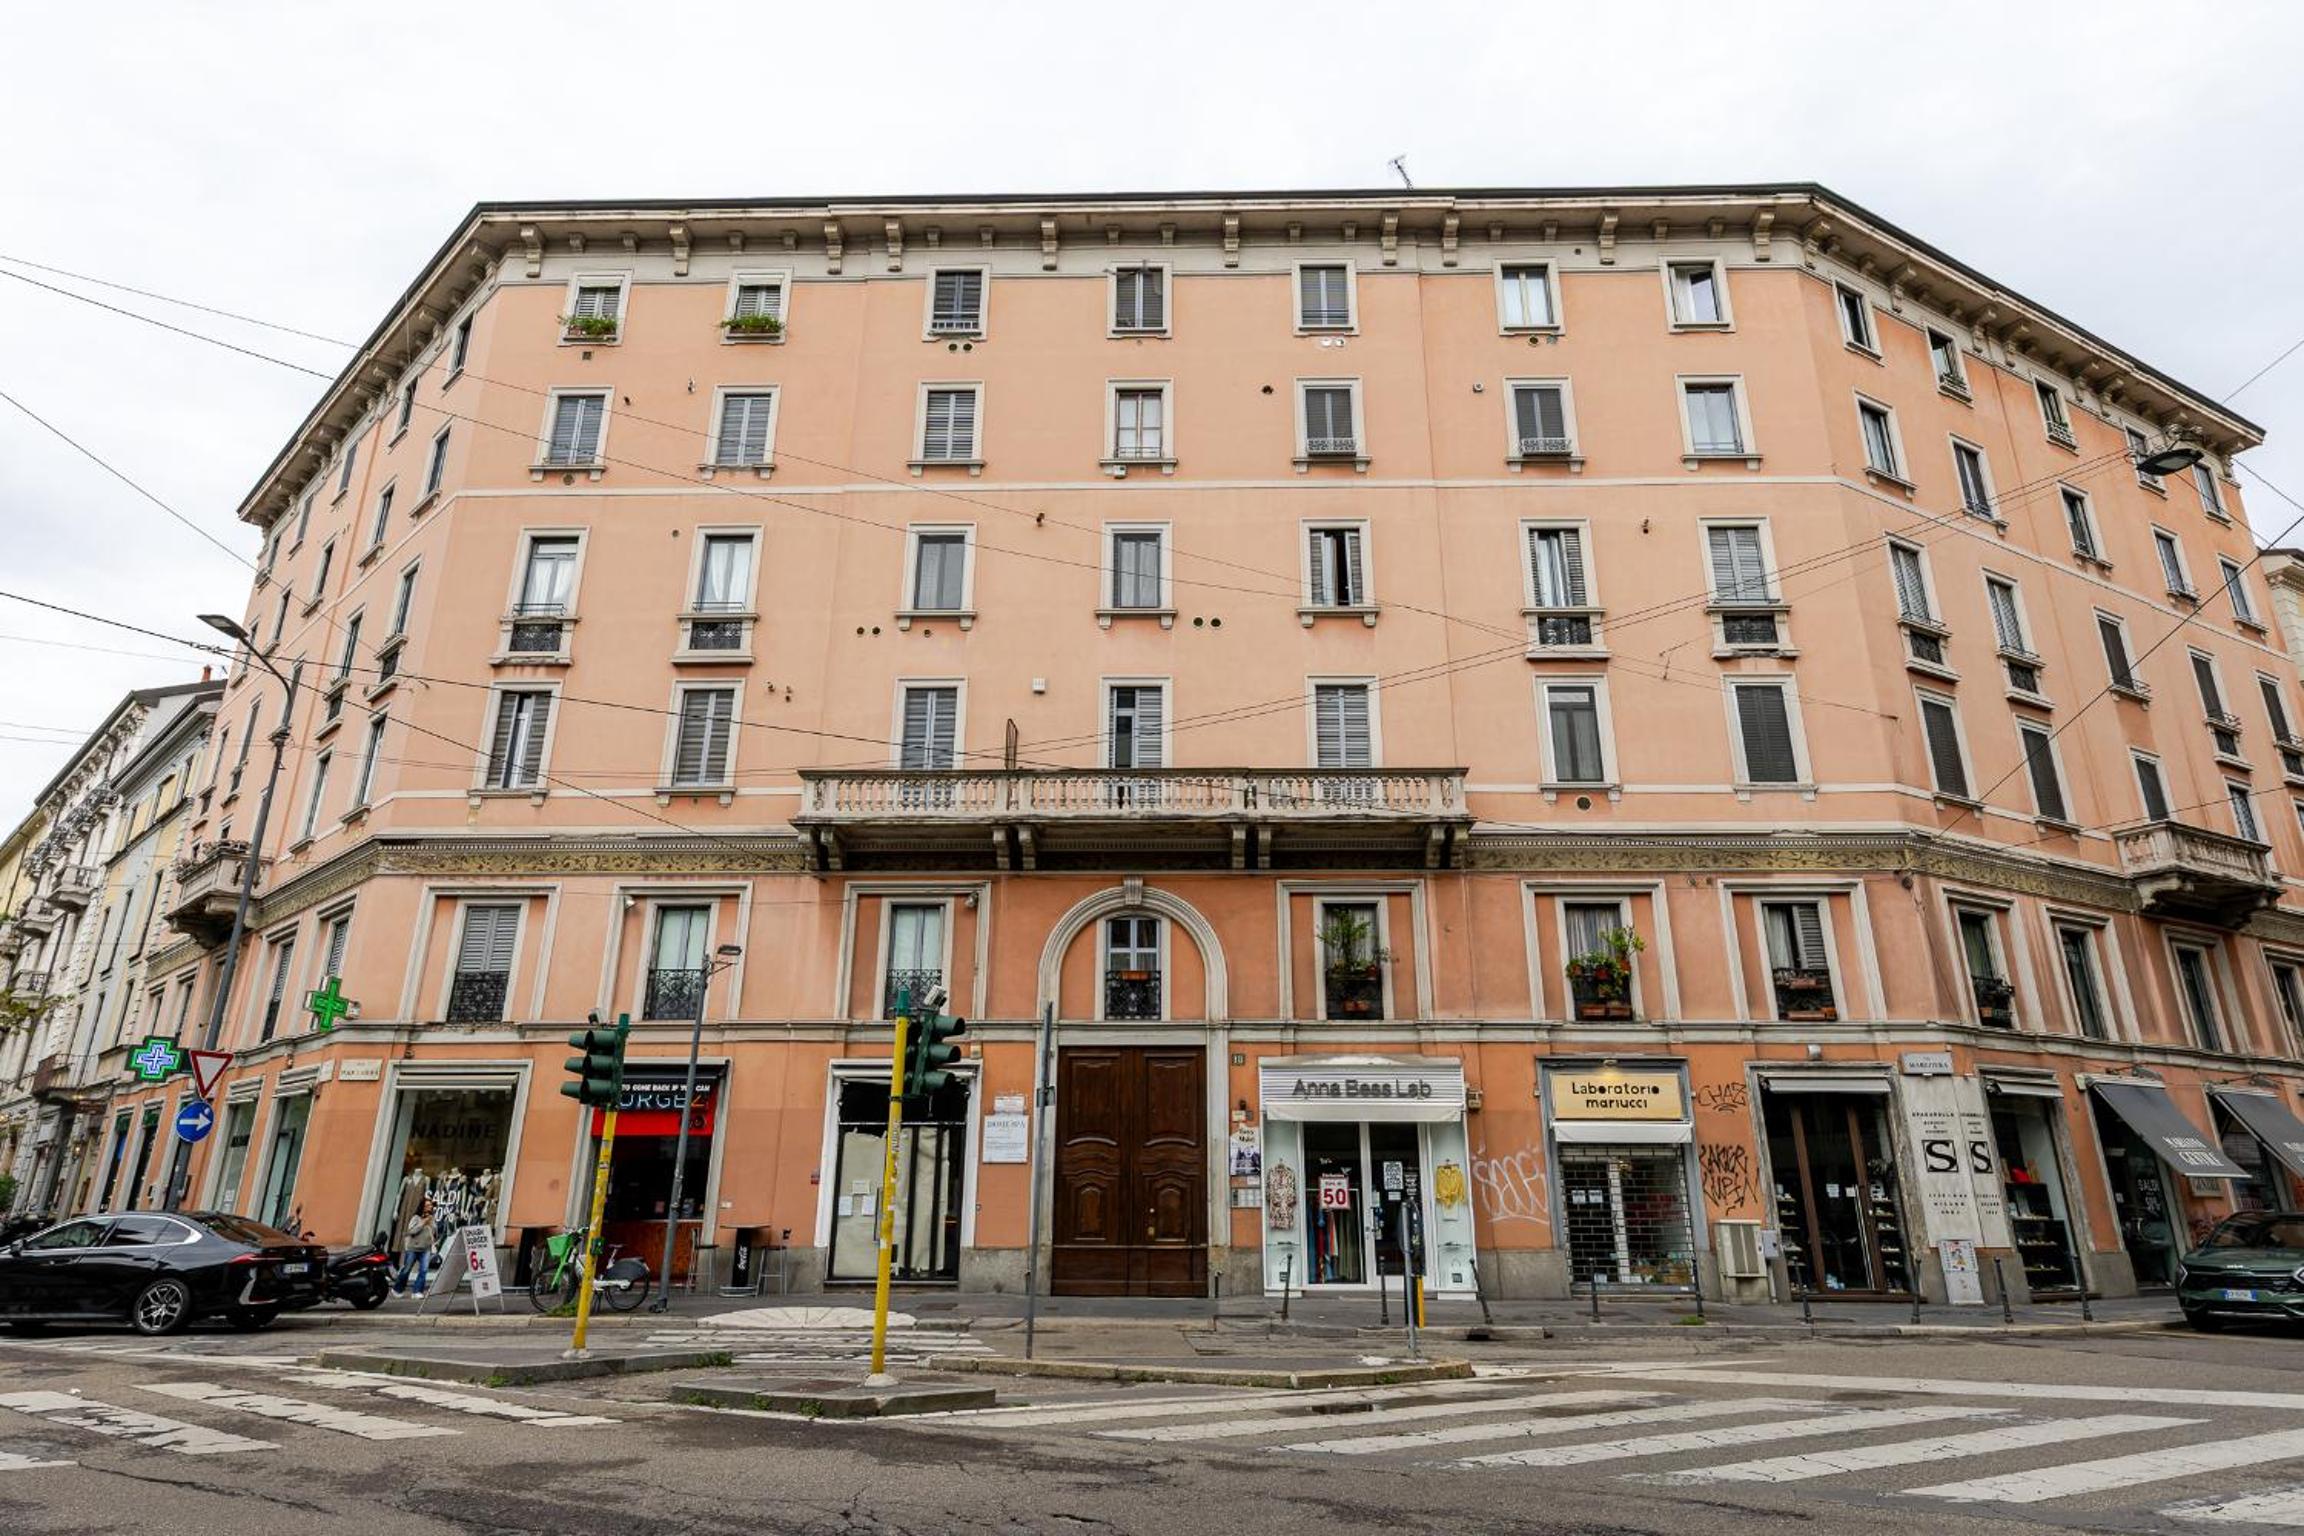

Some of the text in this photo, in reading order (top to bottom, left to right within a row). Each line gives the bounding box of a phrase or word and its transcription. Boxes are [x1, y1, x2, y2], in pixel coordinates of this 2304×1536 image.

[1292, 1078, 1342, 1097] Anna
[1571, 1082, 1660, 1095] Laboratorio
[1585, 1099, 1648, 1109] mariucci
[1323, 1188, 1347, 1205] 50
